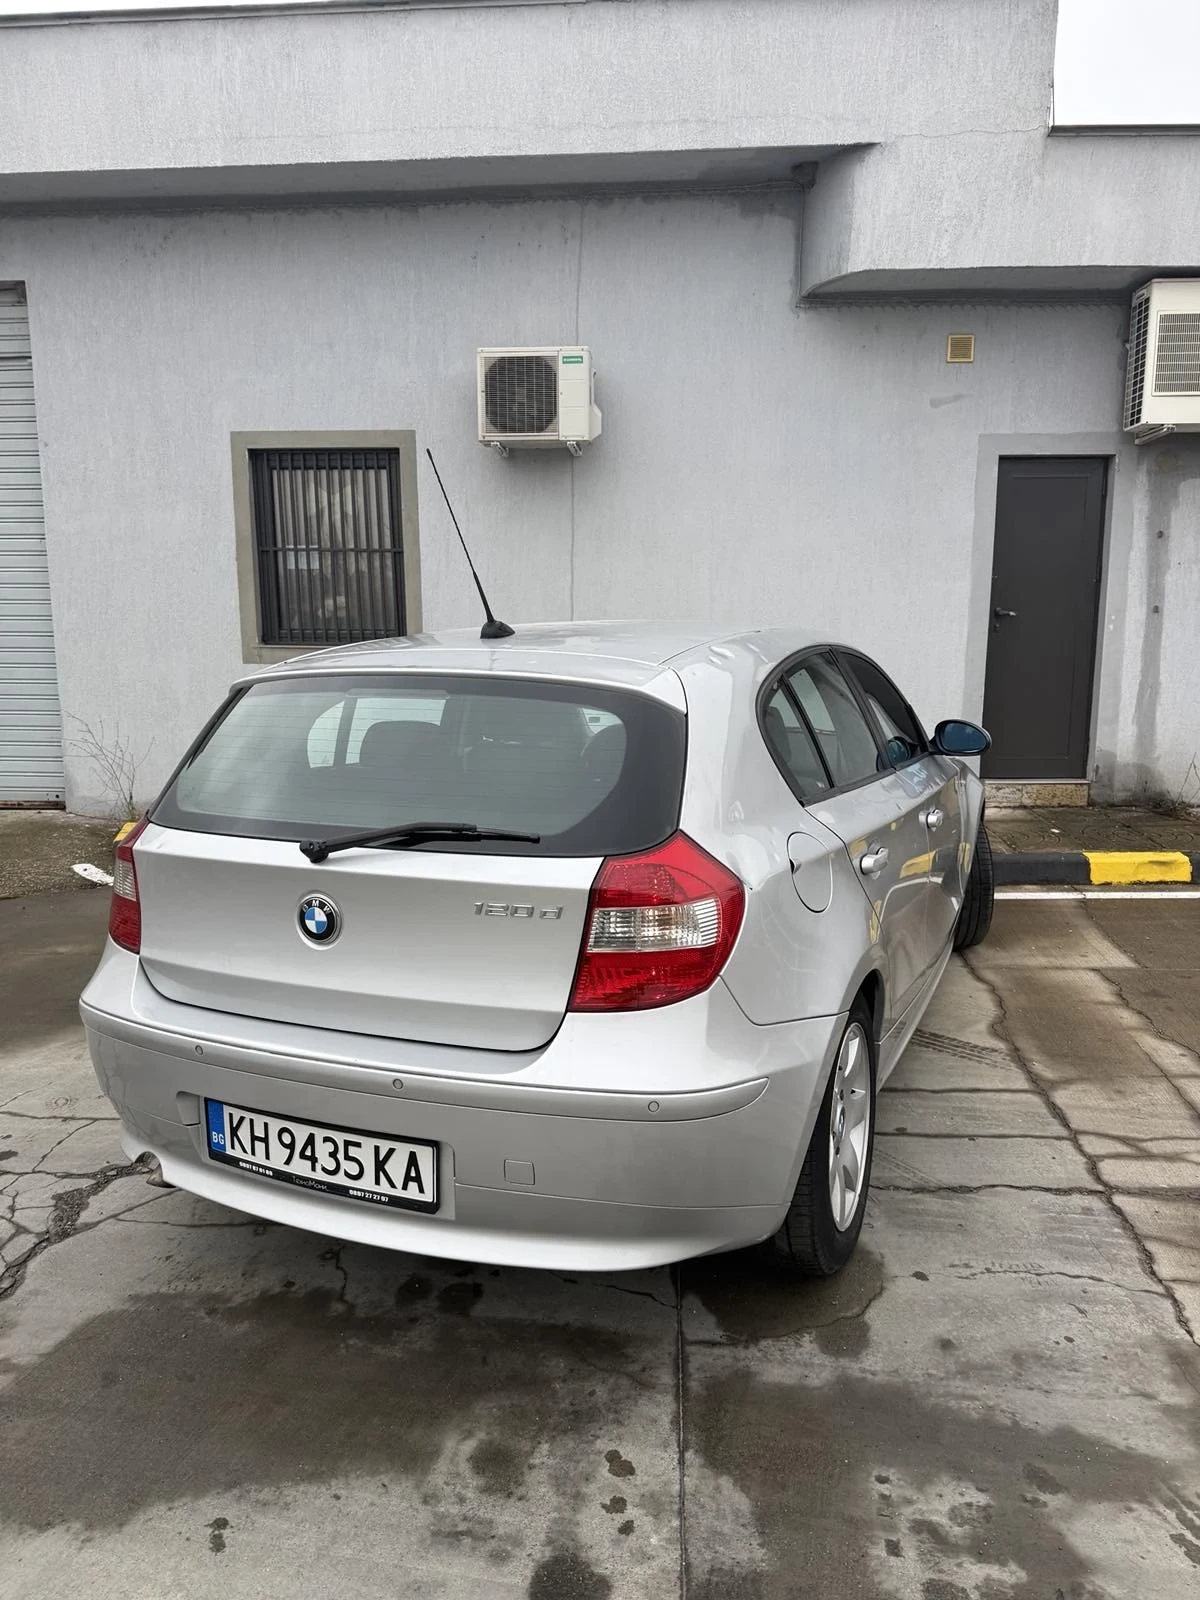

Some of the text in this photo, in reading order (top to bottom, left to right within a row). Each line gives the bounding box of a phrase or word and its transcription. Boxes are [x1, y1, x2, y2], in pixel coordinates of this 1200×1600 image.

[302, 899, 332, 914] BMW
[212, 1131, 225, 1145] BG
[277, 1126, 365, 1182] 9435
